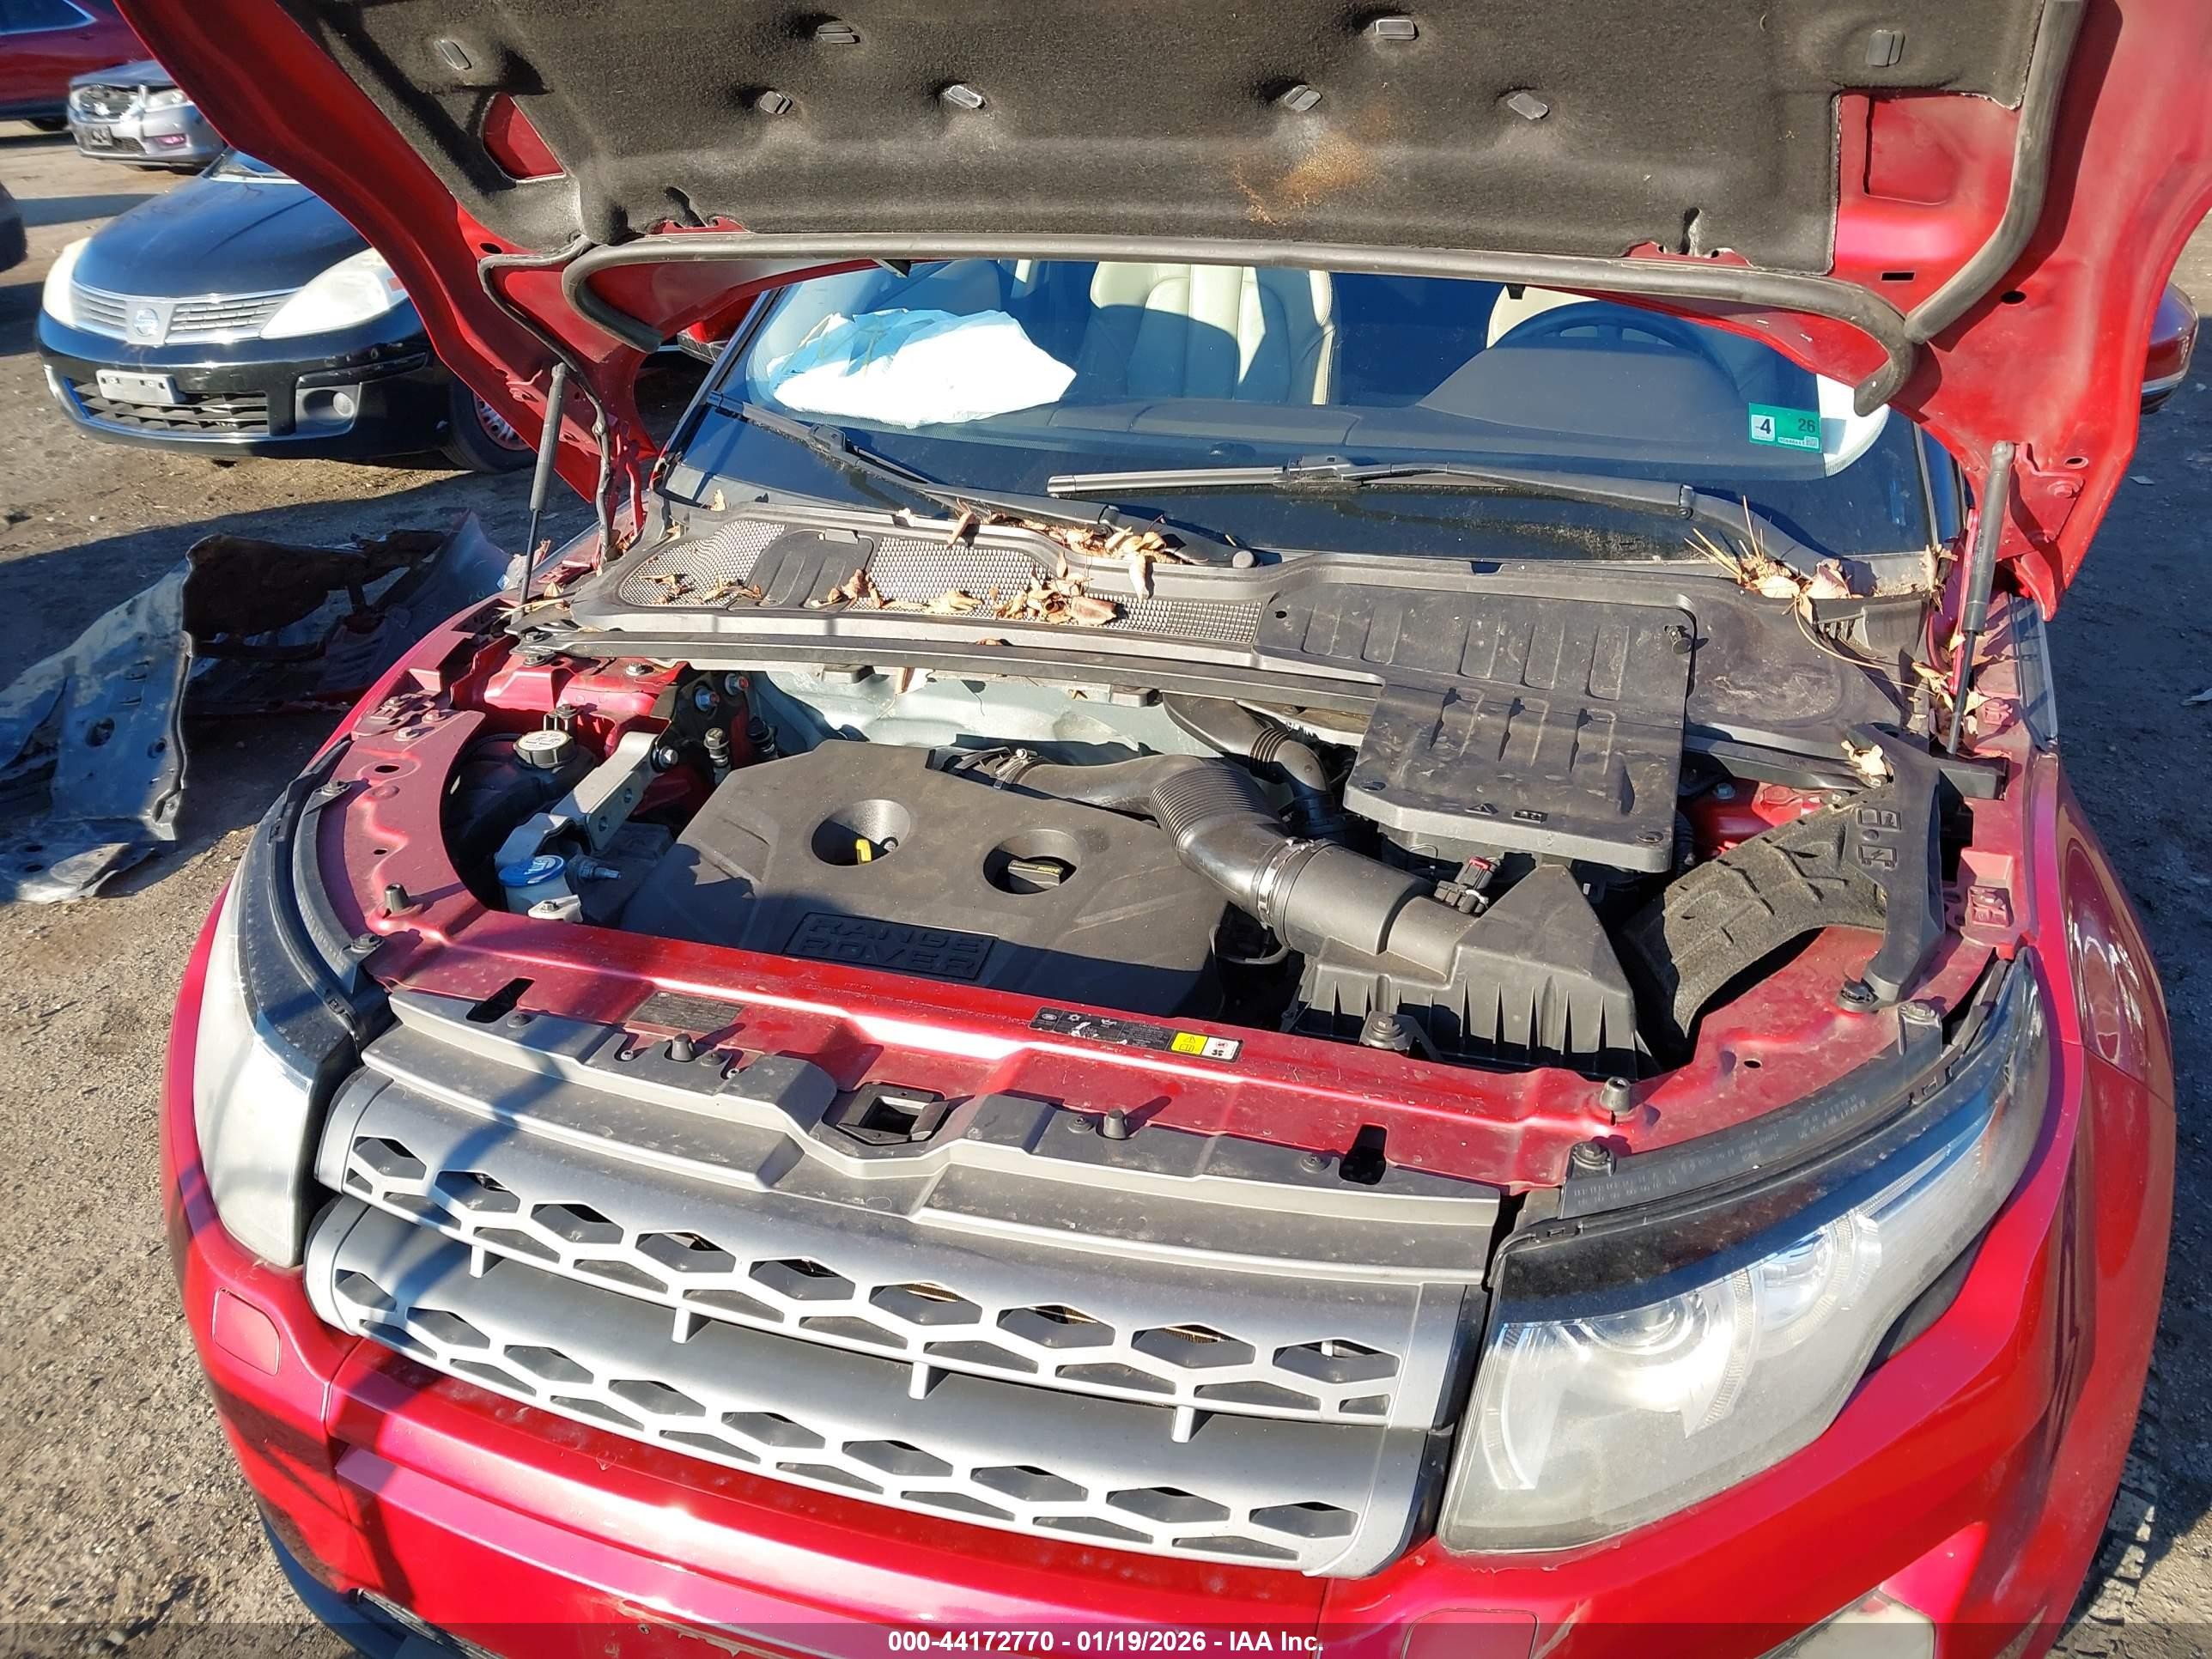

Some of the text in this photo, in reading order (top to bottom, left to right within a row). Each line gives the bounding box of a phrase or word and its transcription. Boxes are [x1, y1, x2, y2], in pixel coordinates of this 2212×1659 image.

[1797, 417, 1816, 433] 26
[809, 918, 984, 954] RANGE
[801, 936, 976, 975] ROVER
